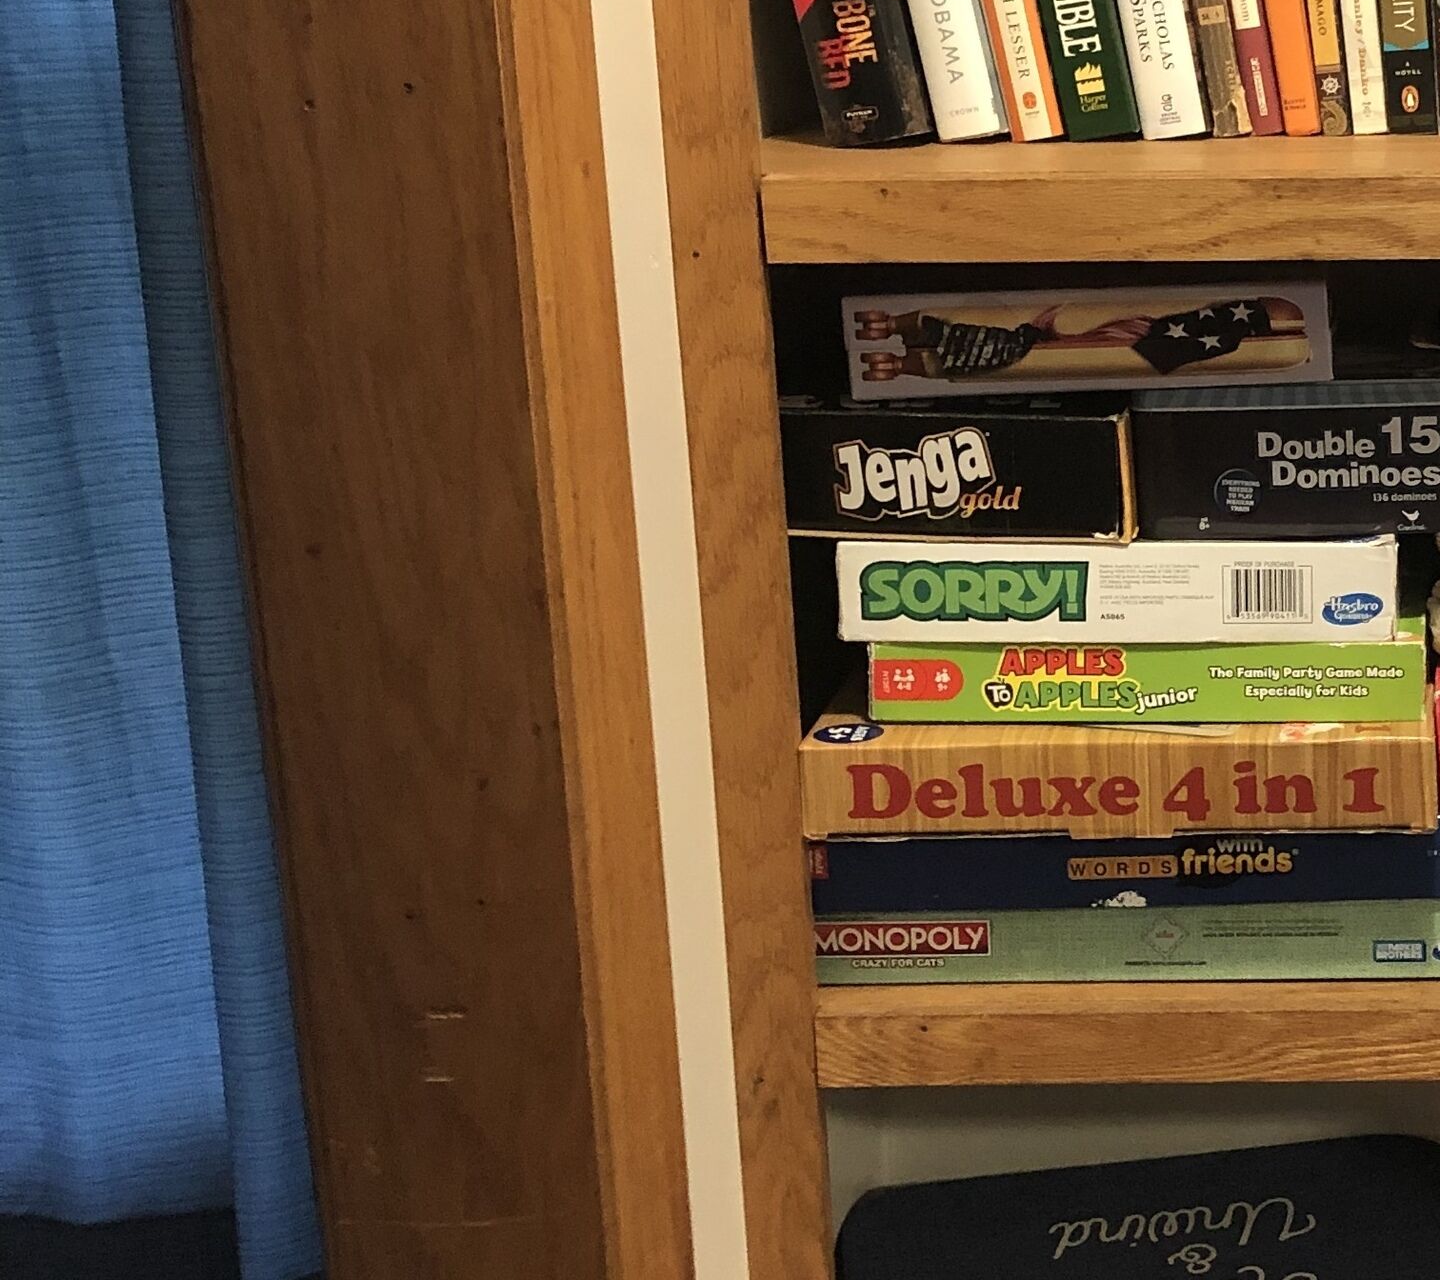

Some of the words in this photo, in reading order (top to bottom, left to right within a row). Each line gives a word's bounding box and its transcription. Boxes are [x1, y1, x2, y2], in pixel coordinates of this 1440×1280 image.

[1005, 9, 1030, 79] LESSER
[817, 37, 850, 91] BED
[1257, 431, 1377, 461] Double
[838, 427, 992, 513] Jenga
[959, 485, 1024, 519] gold
[1372, 493, 1389, 502] 136
[1391, 492, 1437, 502] dominoes
[863, 563, 1086, 619] SORRY!
[1324, 596, 1380, 615] Hasbro
[999, 649, 1125, 677] APPLES
[1209, 667, 1234, 678] The
[1236, 667, 1281, 681] Family
[1283, 667, 1323, 681] Party
[1326, 667, 1363, 678] Game
[1366, 666, 1405, 678] Made
[1014, 681, 1138, 709] APPLES
[1136, 686, 1198, 714] junior
[1245, 685, 1313, 700] Especially
[1315, 685, 1337, 697] for
[1339, 685, 1369, 697] Kids
[846, 763, 1141, 820] Deluxe
[1162, 766, 1212, 821] 4
[1232, 760, 1318, 815] in
[1342, 767, 1386, 814] 1
[1070, 860, 1172, 877] WORDS
[1181, 848, 1293, 877] friends
[815, 926, 986, 953] MONOPOLY
[852, 959, 888, 969] CRAZY
[890, 958, 914, 968] FOR
[916, 958, 945, 968] CATS
[1048, 1196, 1317, 1261] Unwind
[1166, 1244, 1217, 1274] &
